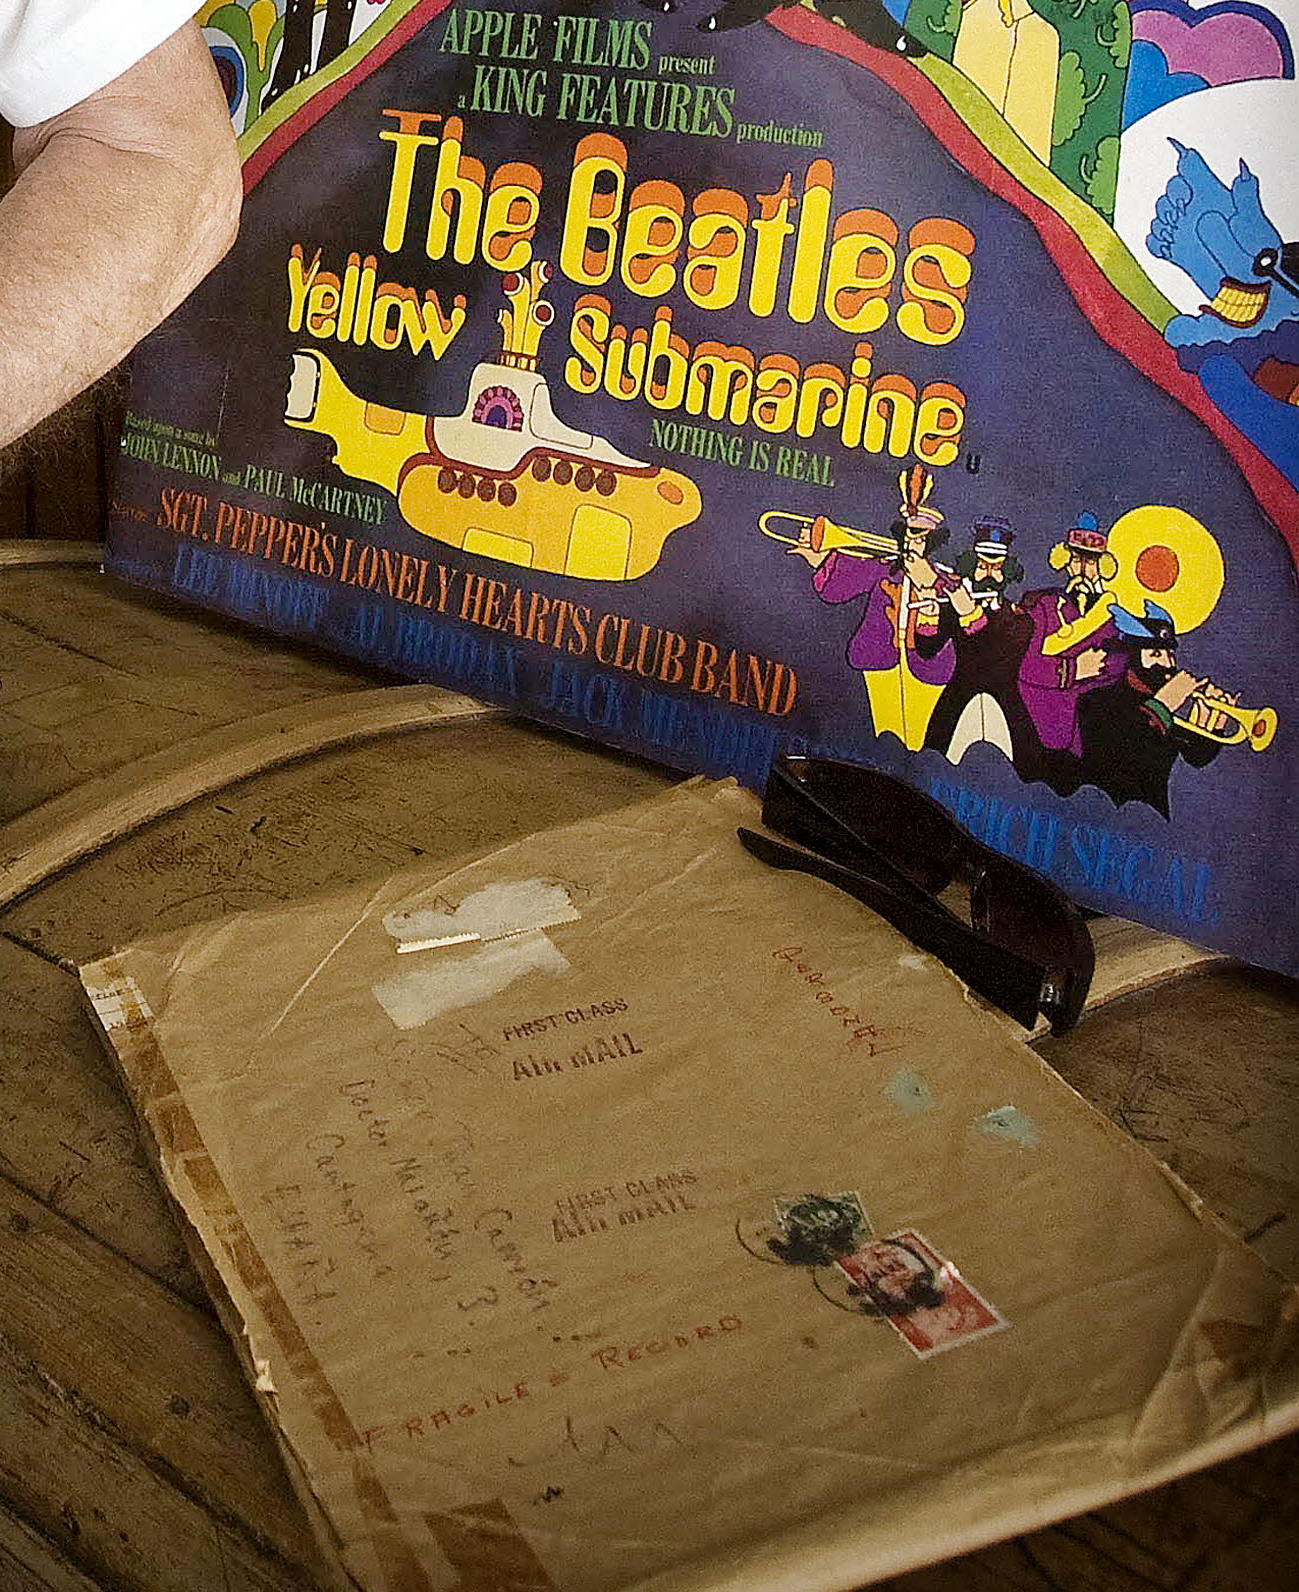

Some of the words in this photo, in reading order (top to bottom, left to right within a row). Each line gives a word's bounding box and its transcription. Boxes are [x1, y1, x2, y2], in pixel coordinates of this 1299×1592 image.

[439, 7, 544, 61] APPLE
[552, 16, 655, 72] FILMS
[658, 52, 718, 77] present
[456, 93, 467, 110] a
[469, 63, 549, 118] KING
[556, 72, 737, 140] FEATURES
[735, 121, 826, 150] production
[379, 108, 545, 273] The
[560, 132, 980, 348] Beatles
[286, 242, 468, 362] Yellow
[563, 292, 969, 468] Submarine
[121, 432, 160, 466] JOHN
[161, 441, 222, 481] LENNON
[222, 470, 242, 486] and
[244, 463, 287, 500] PAUL
[289, 475, 388, 525] McCARTNEY
[649, 417, 746, 468] NOTHING
[748, 439, 771, 473] IS
[775, 445, 836, 489] REAL
[157, 486, 211, 542] SGT.
[214, 500, 341, 579] PEPPER'S
[340, 538, 461, 614] LONELY
[459, 571, 592, 657] HEARTS
[594, 612, 688, 684] CLUB
[689, 638, 799, 717] BAND
[503, 1014, 558, 1042] FIRST
[564, 997, 629, 1025] CLASS
[569, 1032, 644, 1069] MAIL
[556, 1186, 619, 1217] FIRST
[624, 1169, 699, 1199] CLASS
[361, 1380, 530, 1454] FRAGILE
[590, 1313, 744, 1372] RECORD
